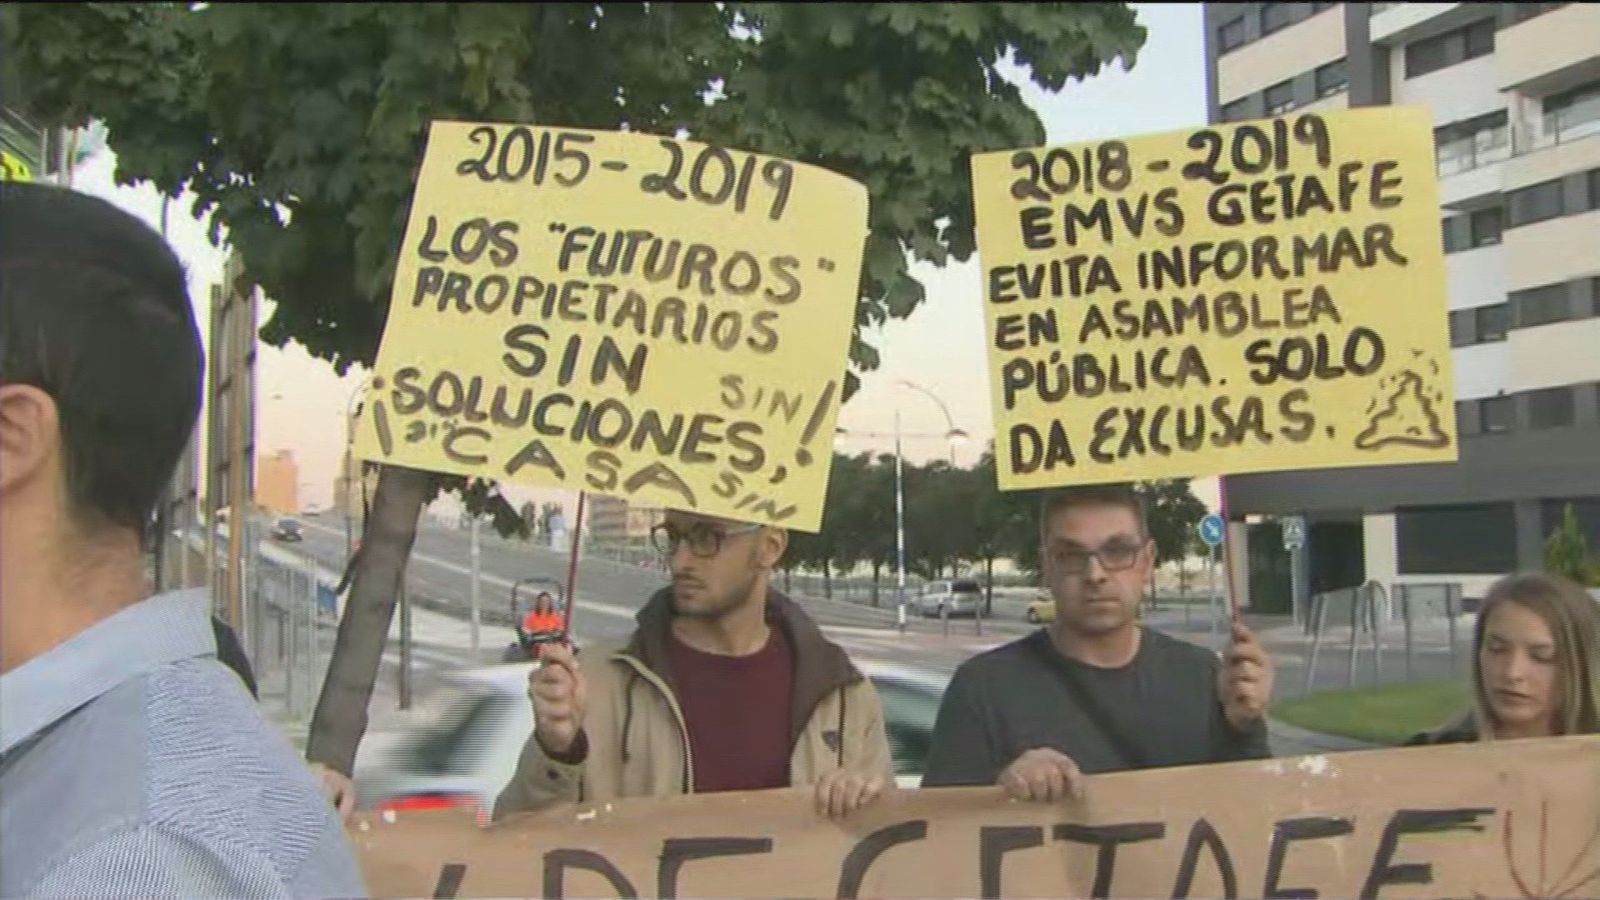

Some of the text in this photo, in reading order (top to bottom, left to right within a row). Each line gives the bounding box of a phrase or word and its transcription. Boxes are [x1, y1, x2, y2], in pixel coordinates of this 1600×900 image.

[417, 215, 520, 268] LOS
[1018, 159, 1405, 251] EMVS GETAFE
[988, 221, 1409, 305] EVITA INFORMAR
[411, 265, 780, 354] PROPIETARIOS
[994, 283, 1344, 352] EN ASAMBLEA
[502, 323, 650, 396] SIN
[719, 374, 803, 421] SIN
[1001, 325, 1388, 411] PÚBLICA. SOLO
[442, 426, 698, 509] CASA
[1009, 387, 1337, 476] DA EXCUSAS.
[710, 472, 798, 521] SIN
